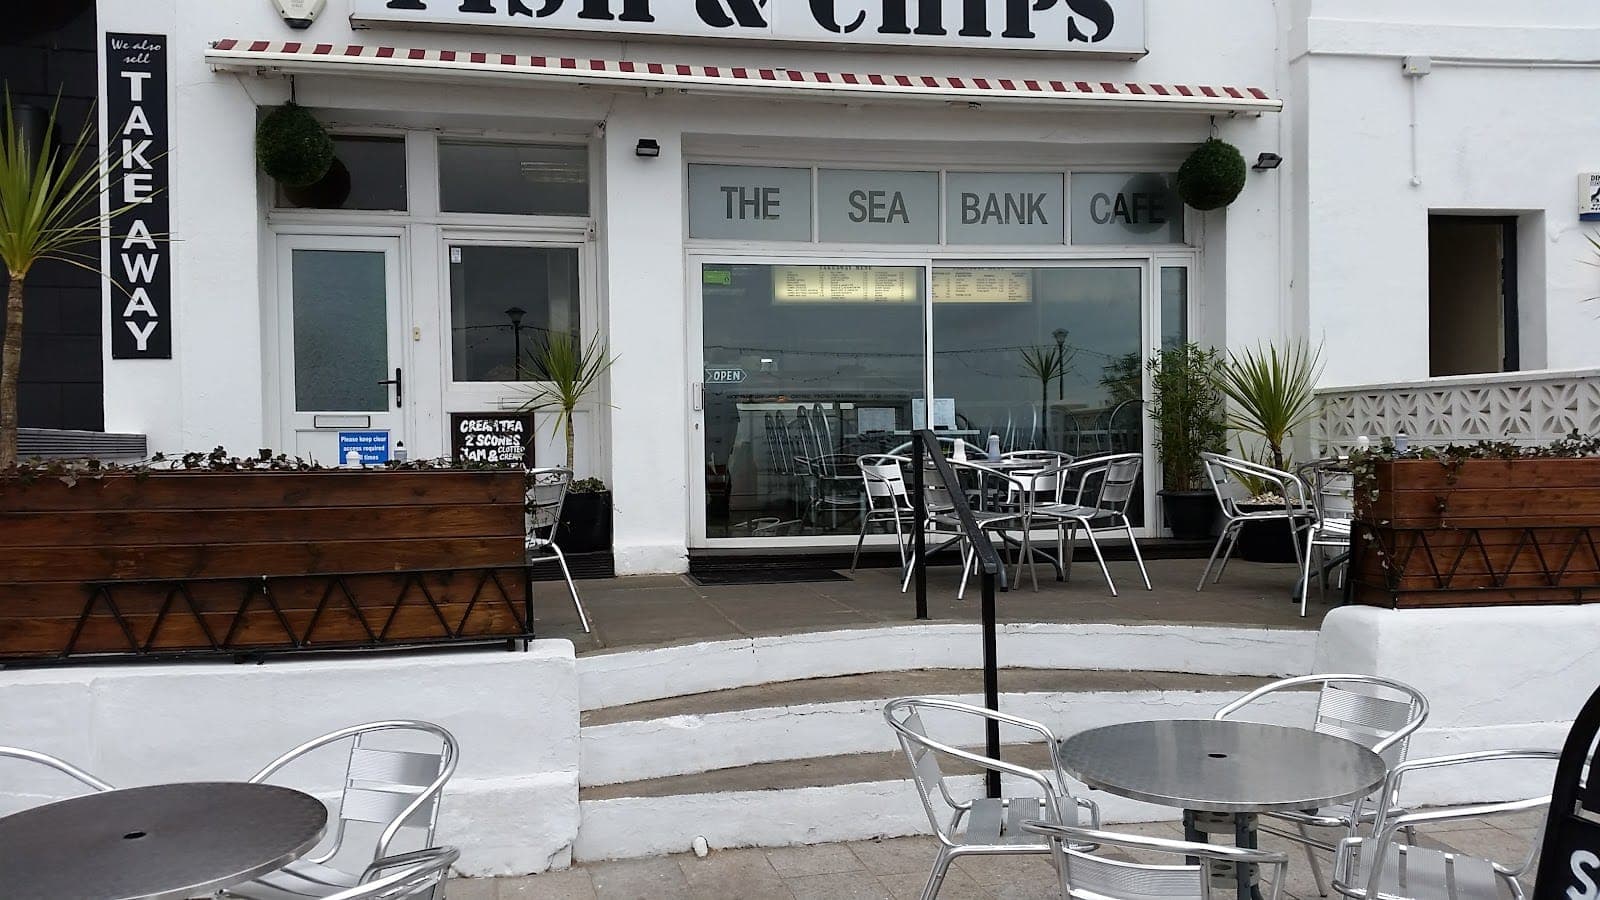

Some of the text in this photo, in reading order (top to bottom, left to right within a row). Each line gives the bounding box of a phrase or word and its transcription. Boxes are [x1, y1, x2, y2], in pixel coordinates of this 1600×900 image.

[111, 38, 161, 51] We also
[123, 52, 151, 64] sell
[120, 71, 154, 203] TAKE
[720, 186, 780, 220] THE
[848, 189, 910, 224] SEA
[961, 192, 1048, 225] BANK
[120, 219, 160, 351] AWAY
[713, 370, 741, 381] OPEN
[499, 419, 524, 433] TEA
[359, 435, 372, 444] keep
[464, 434, 521, 446] 2 SCONES
[363, 445, 385, 453] required
[488, 449, 499, 462] &
[1566, 853, 1600, 900] S
